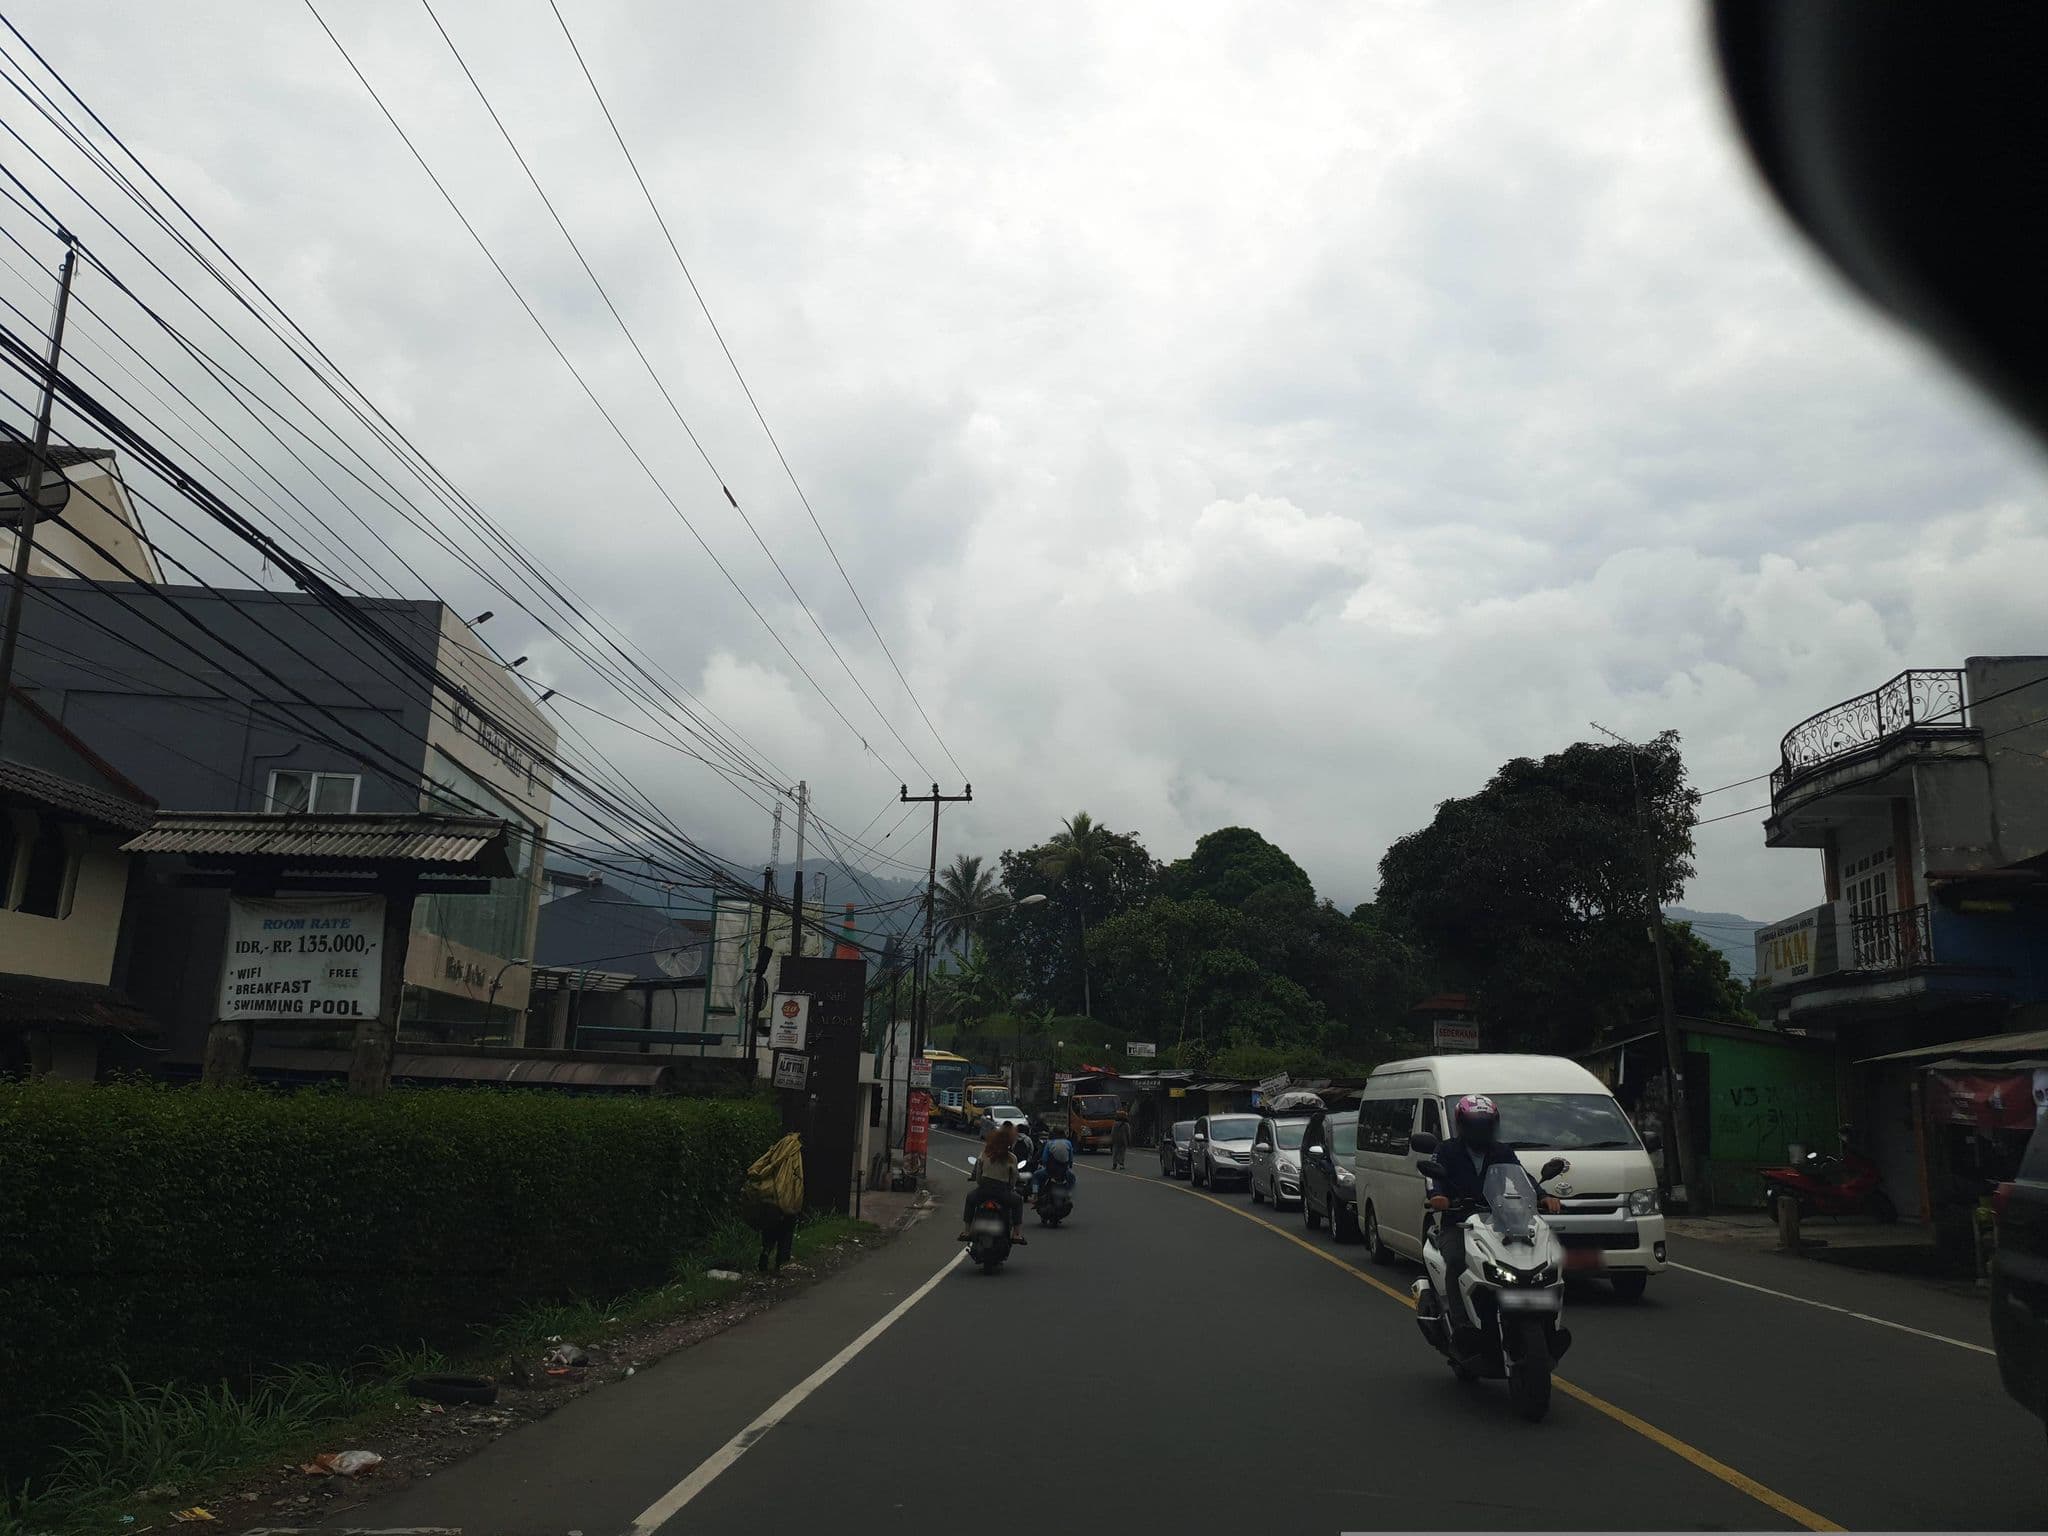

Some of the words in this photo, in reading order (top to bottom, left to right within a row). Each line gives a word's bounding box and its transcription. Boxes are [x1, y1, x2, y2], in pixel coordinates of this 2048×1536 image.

[263, 919, 305, 930] ROOM
[310, 918, 352, 929] RATE
[1775, 930, 1808, 969] LKM
[238, 967, 262, 980] WIFI
[329, 968, 358, 978] FREE
[235, 980, 311, 995] BREAKFAST
[234, 1000, 303, 1014] SWIMMING
[310, 1000, 363, 1016] POOL
